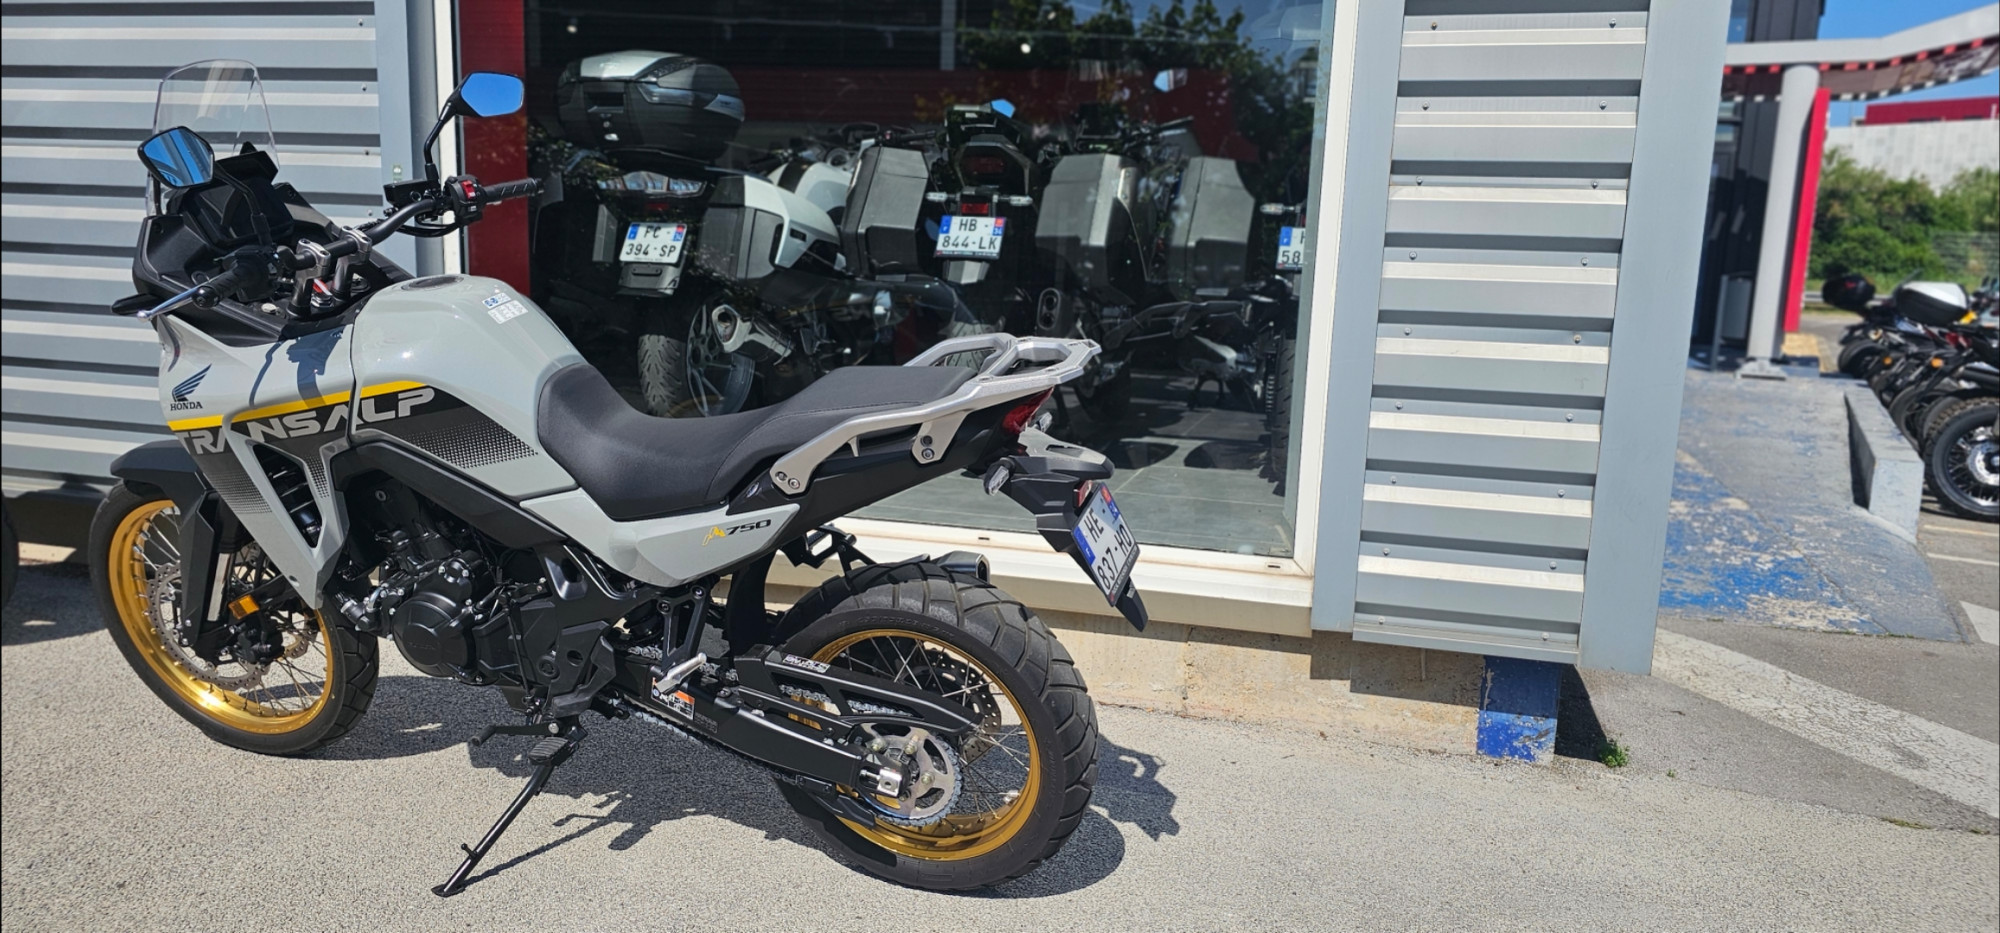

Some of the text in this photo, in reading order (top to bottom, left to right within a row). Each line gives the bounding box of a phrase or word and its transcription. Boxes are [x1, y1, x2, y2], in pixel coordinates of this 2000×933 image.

[643, 225, 661, 239] FC
[959, 218, 978, 232] HB
[942, 235, 998, 250] 844-LK
[170, 401, 203, 411] HONDA
[726, 519, 772, 536] 750
[1084, 508, 1104, 543] HE
